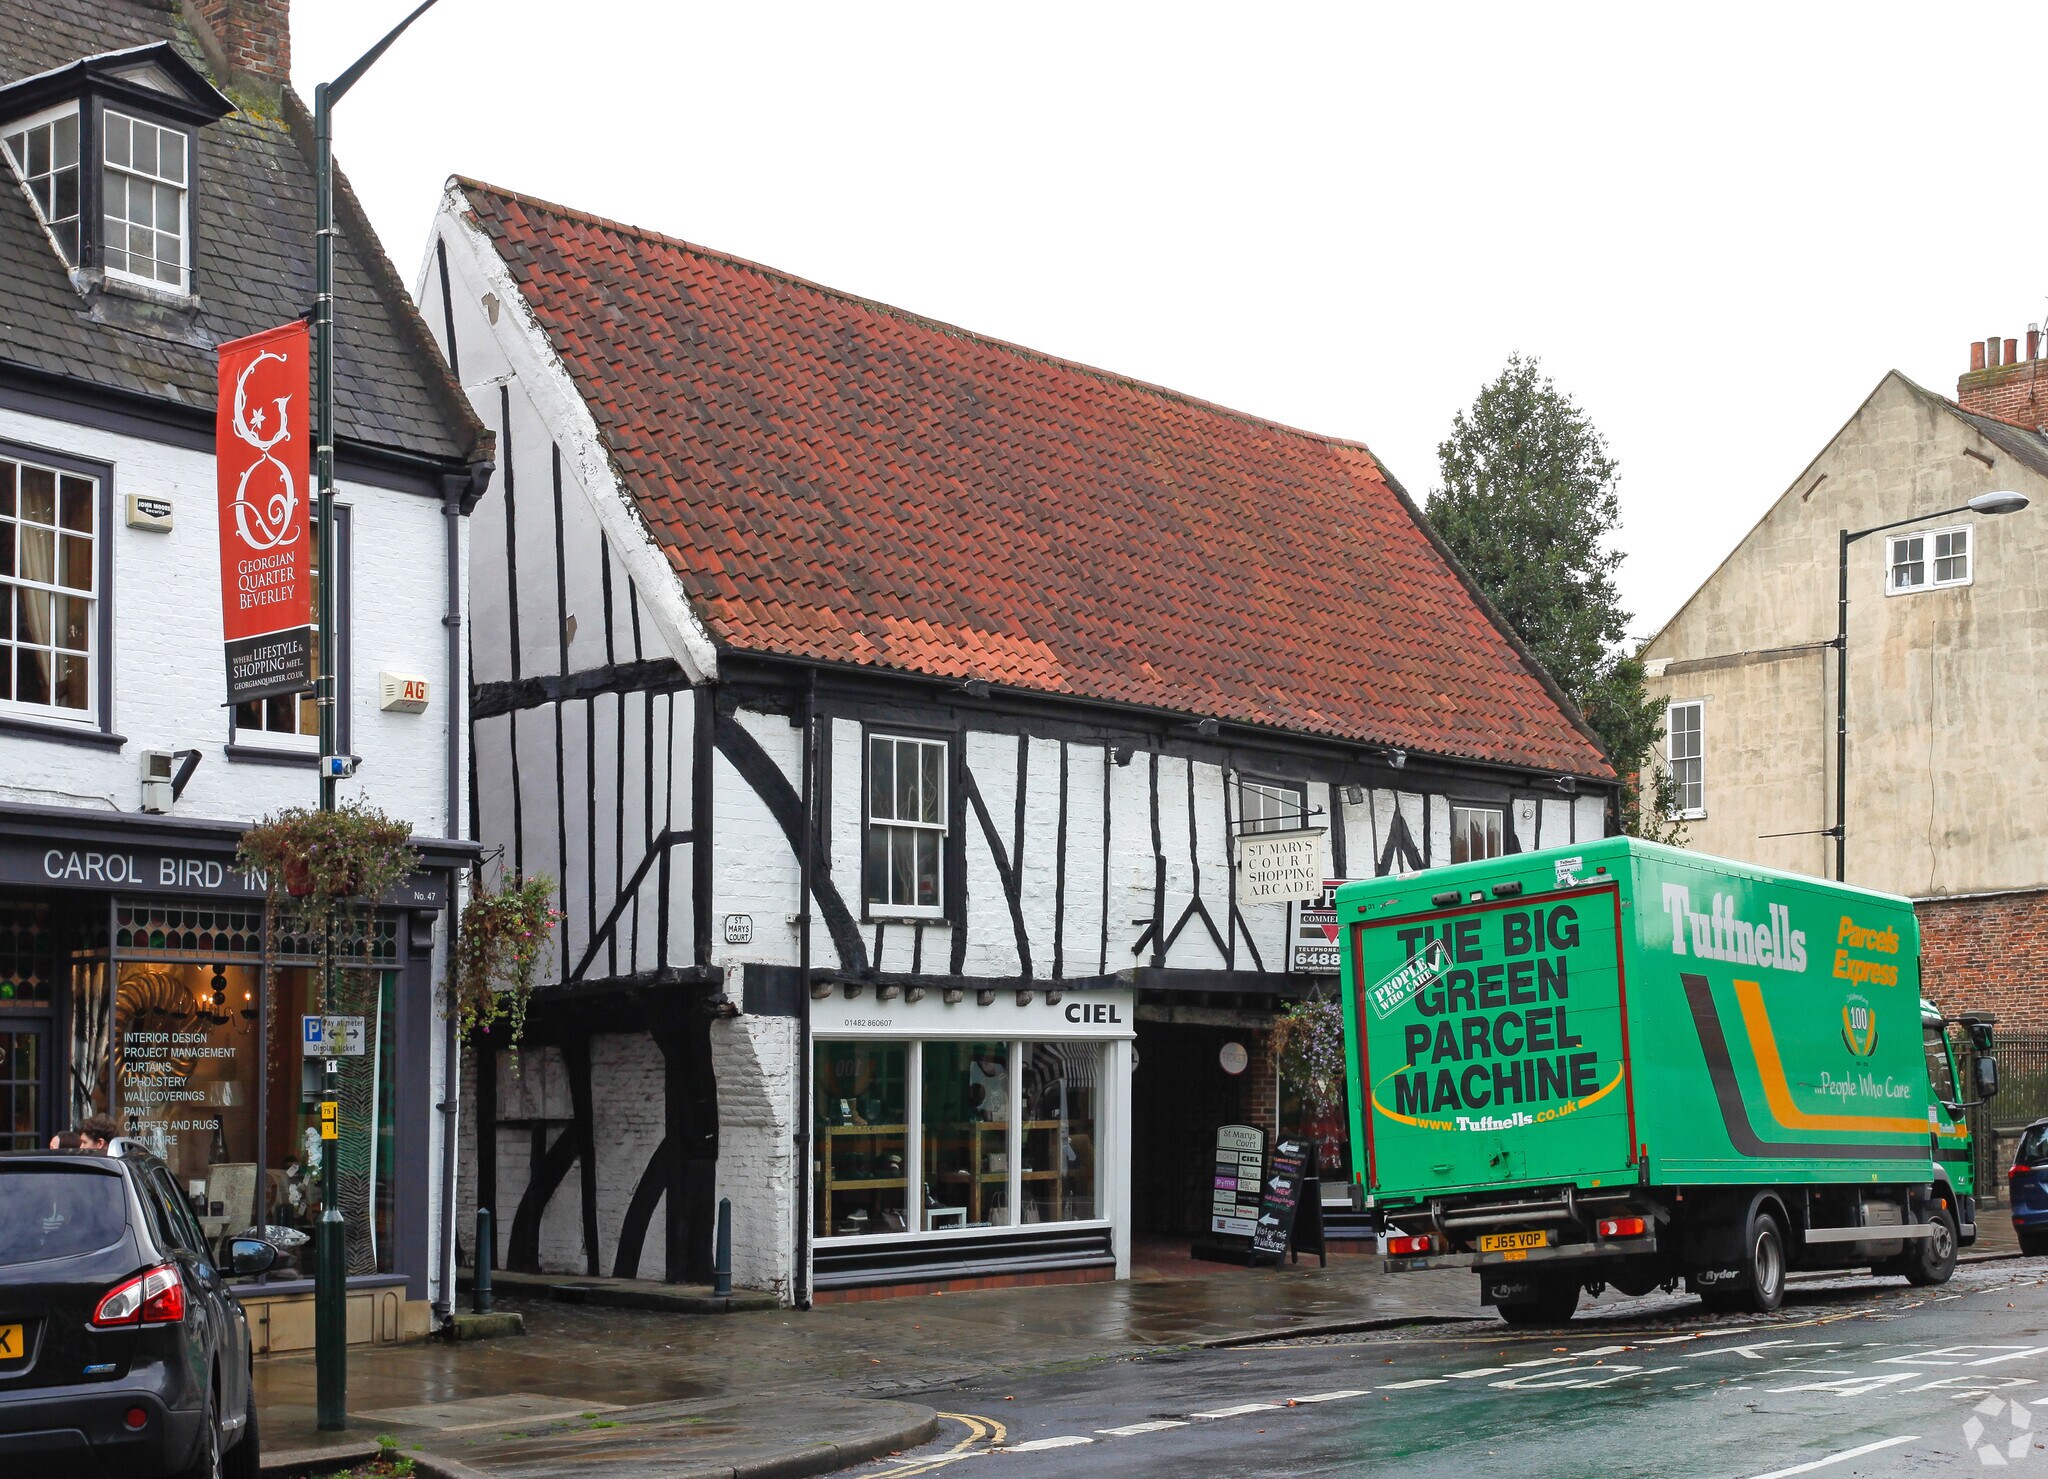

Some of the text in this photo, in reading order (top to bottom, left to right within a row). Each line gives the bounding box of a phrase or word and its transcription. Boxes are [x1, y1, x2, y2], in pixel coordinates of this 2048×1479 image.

[238, 551, 294, 574] GEORGIAN
[238, 567, 295, 592] QUARTER
[240, 585, 294, 610] BEVERLEY
[233, 654, 252, 664] WHERE
[254, 640, 298, 660] LIFESTYLE
[234, 657, 284, 678] SHOPPING
[404, 680, 424, 699] AG
[1248, 845, 1264, 856] ST
[44, 849, 142, 883] CAROL
[160, 858, 223, 888] BIRD
[1249, 867, 1314, 882] SHOPPING
[427, 892, 436, 900] 47
[1250, 881, 1314, 896] ARCADE
[1397, 905, 1580, 968] THE BIG
[1662, 882, 1808, 973] Tuffnells
[1837, 915, 1900, 954] Parcels
[1832, 948, 1898, 986] Express
[1374, 957, 1428, 1002] PEOPLE
[1414, 956, 1568, 1017] GREEN
[1380, 970, 1433, 1012] WHO CARE
[844, 1018, 892, 1028] 01482 860607
[1064, 1003, 1122, 1024] CIEL
[1850, 1006, 1868, 1030] 100
[124, 1033, 208, 1043] INTERIOR DESIGN
[309, 1021, 320, 1040] P
[1405, 1006, 1582, 1066] PARCEL
[124, 1048, 236, 1058] PROJECT MANAGEMENT
[125, 1062, 172, 1072] CURTAINS
[124, 1077, 187, 1087] UPHOLSTERY
[1395, 1052, 1600, 1116] MACHINE
[1858, 1072, 1882, 1099] Who
[1886, 1076, 1910, 1098] Care
[124, 1091, 204, 1102] WALLCOVERINGS
[124, 1106, 150, 1116] PAINT
[124, 1120, 218, 1132] CARPETS AND RUGS
[1232, 1130, 1256, 1140] Marys
[1236, 1140, 1256, 1148] Court
[1486, 1233, 1540, 1249] FJ65 VOP
[1706, 1270, 1740, 1282] Ryder
